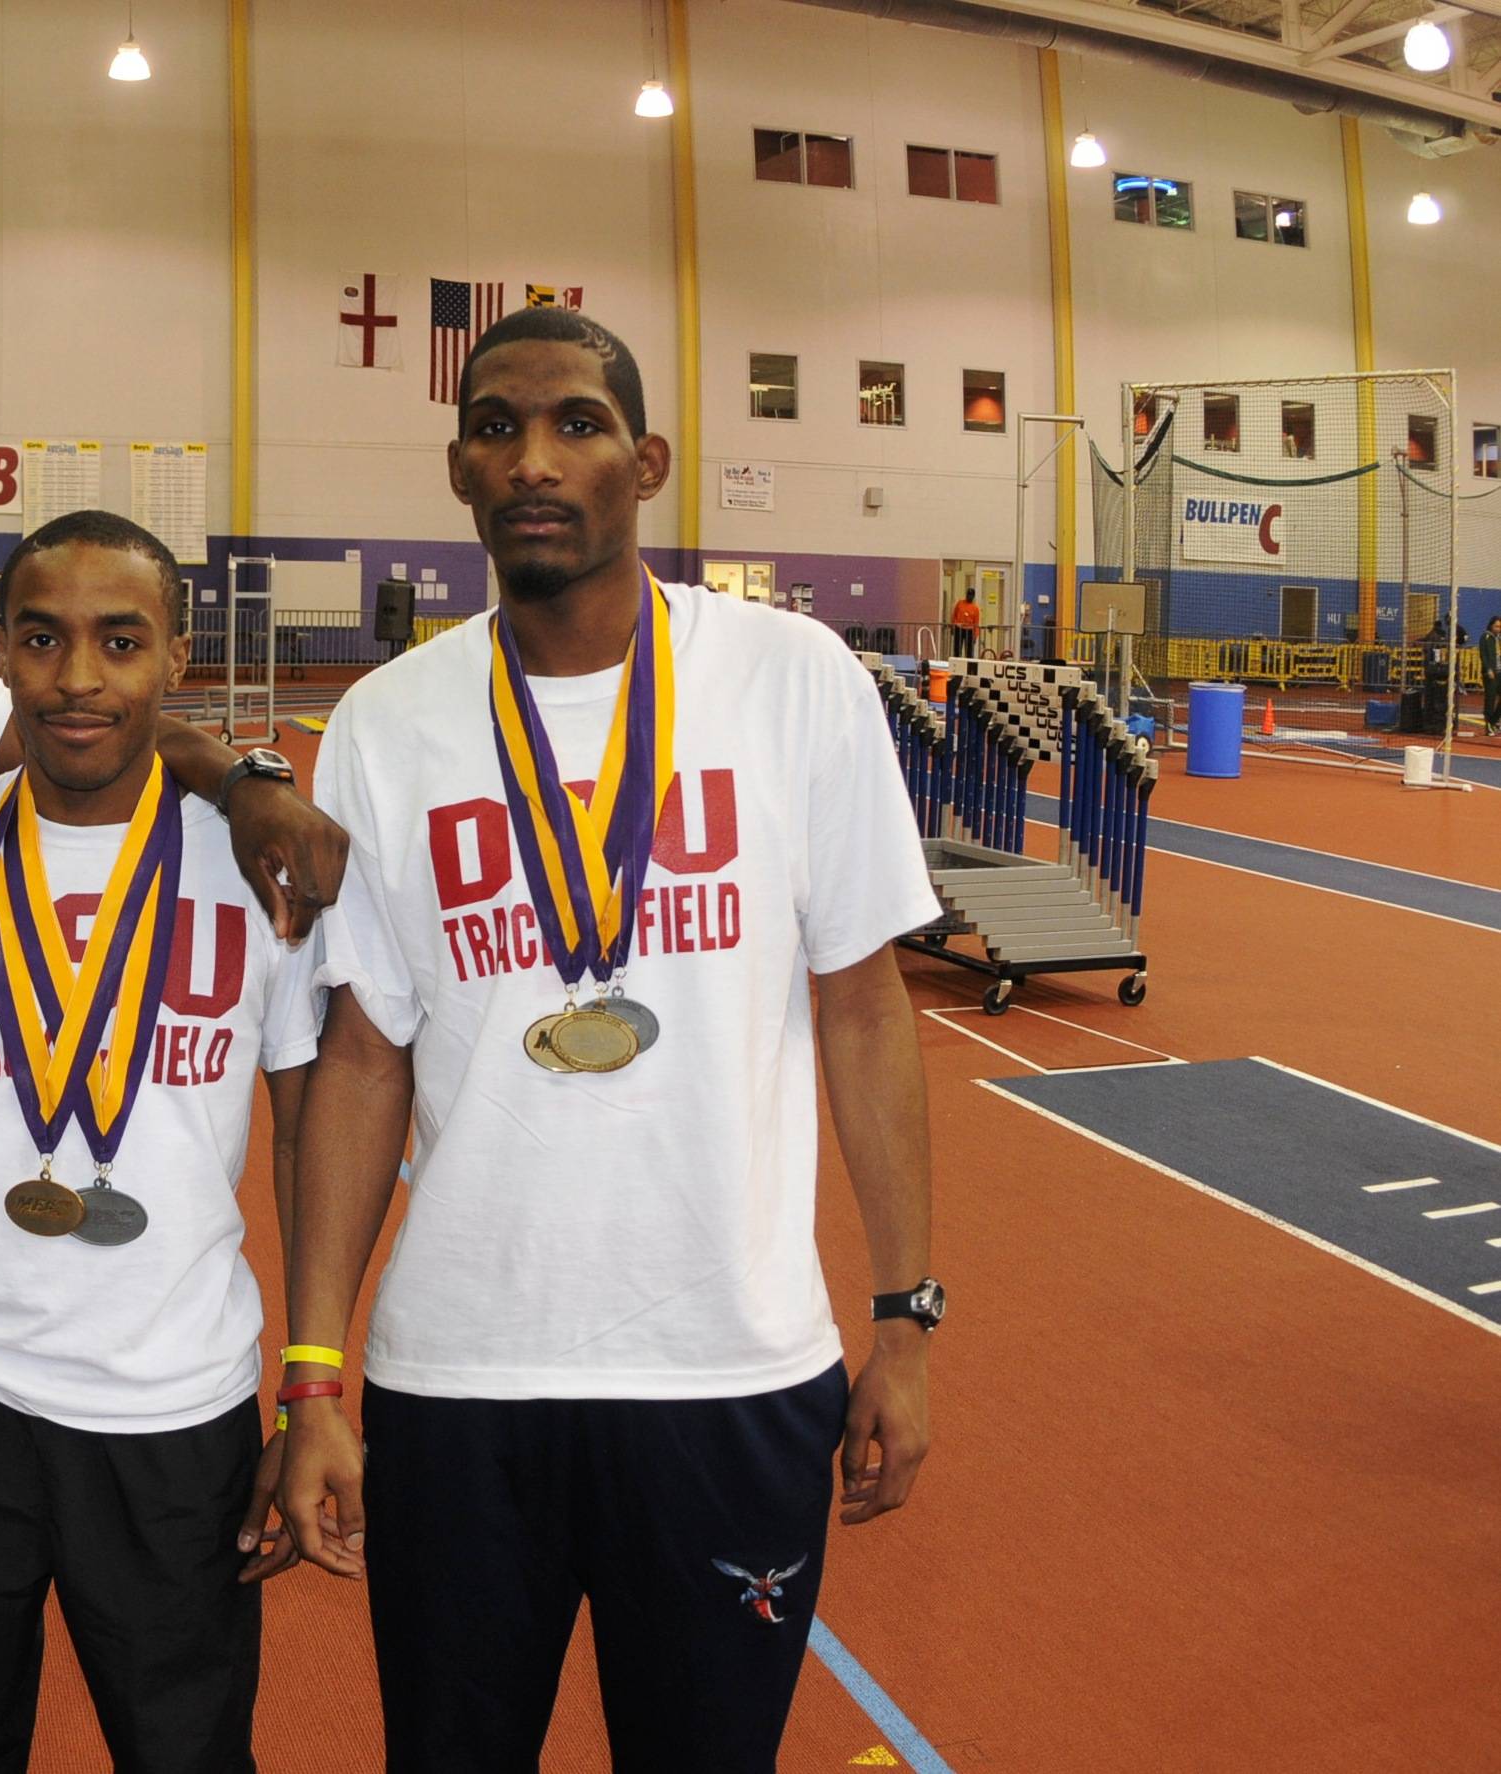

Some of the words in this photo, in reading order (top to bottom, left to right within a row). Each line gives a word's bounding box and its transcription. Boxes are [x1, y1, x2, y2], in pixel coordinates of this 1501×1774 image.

[1185, 498, 1261, 526] BULLPEN
[1259, 504, 1282, 556] C
[993, 664, 1027, 681] UCS
[1007, 679, 1042, 694] UCS
[1017, 692, 1050, 706] UCS
[1024, 704, 1059, 719] UCS
[426, 768, 739, 911] DU
[635, 882, 741, 957] FIELD
[152, 1024, 234, 1087] IELD
